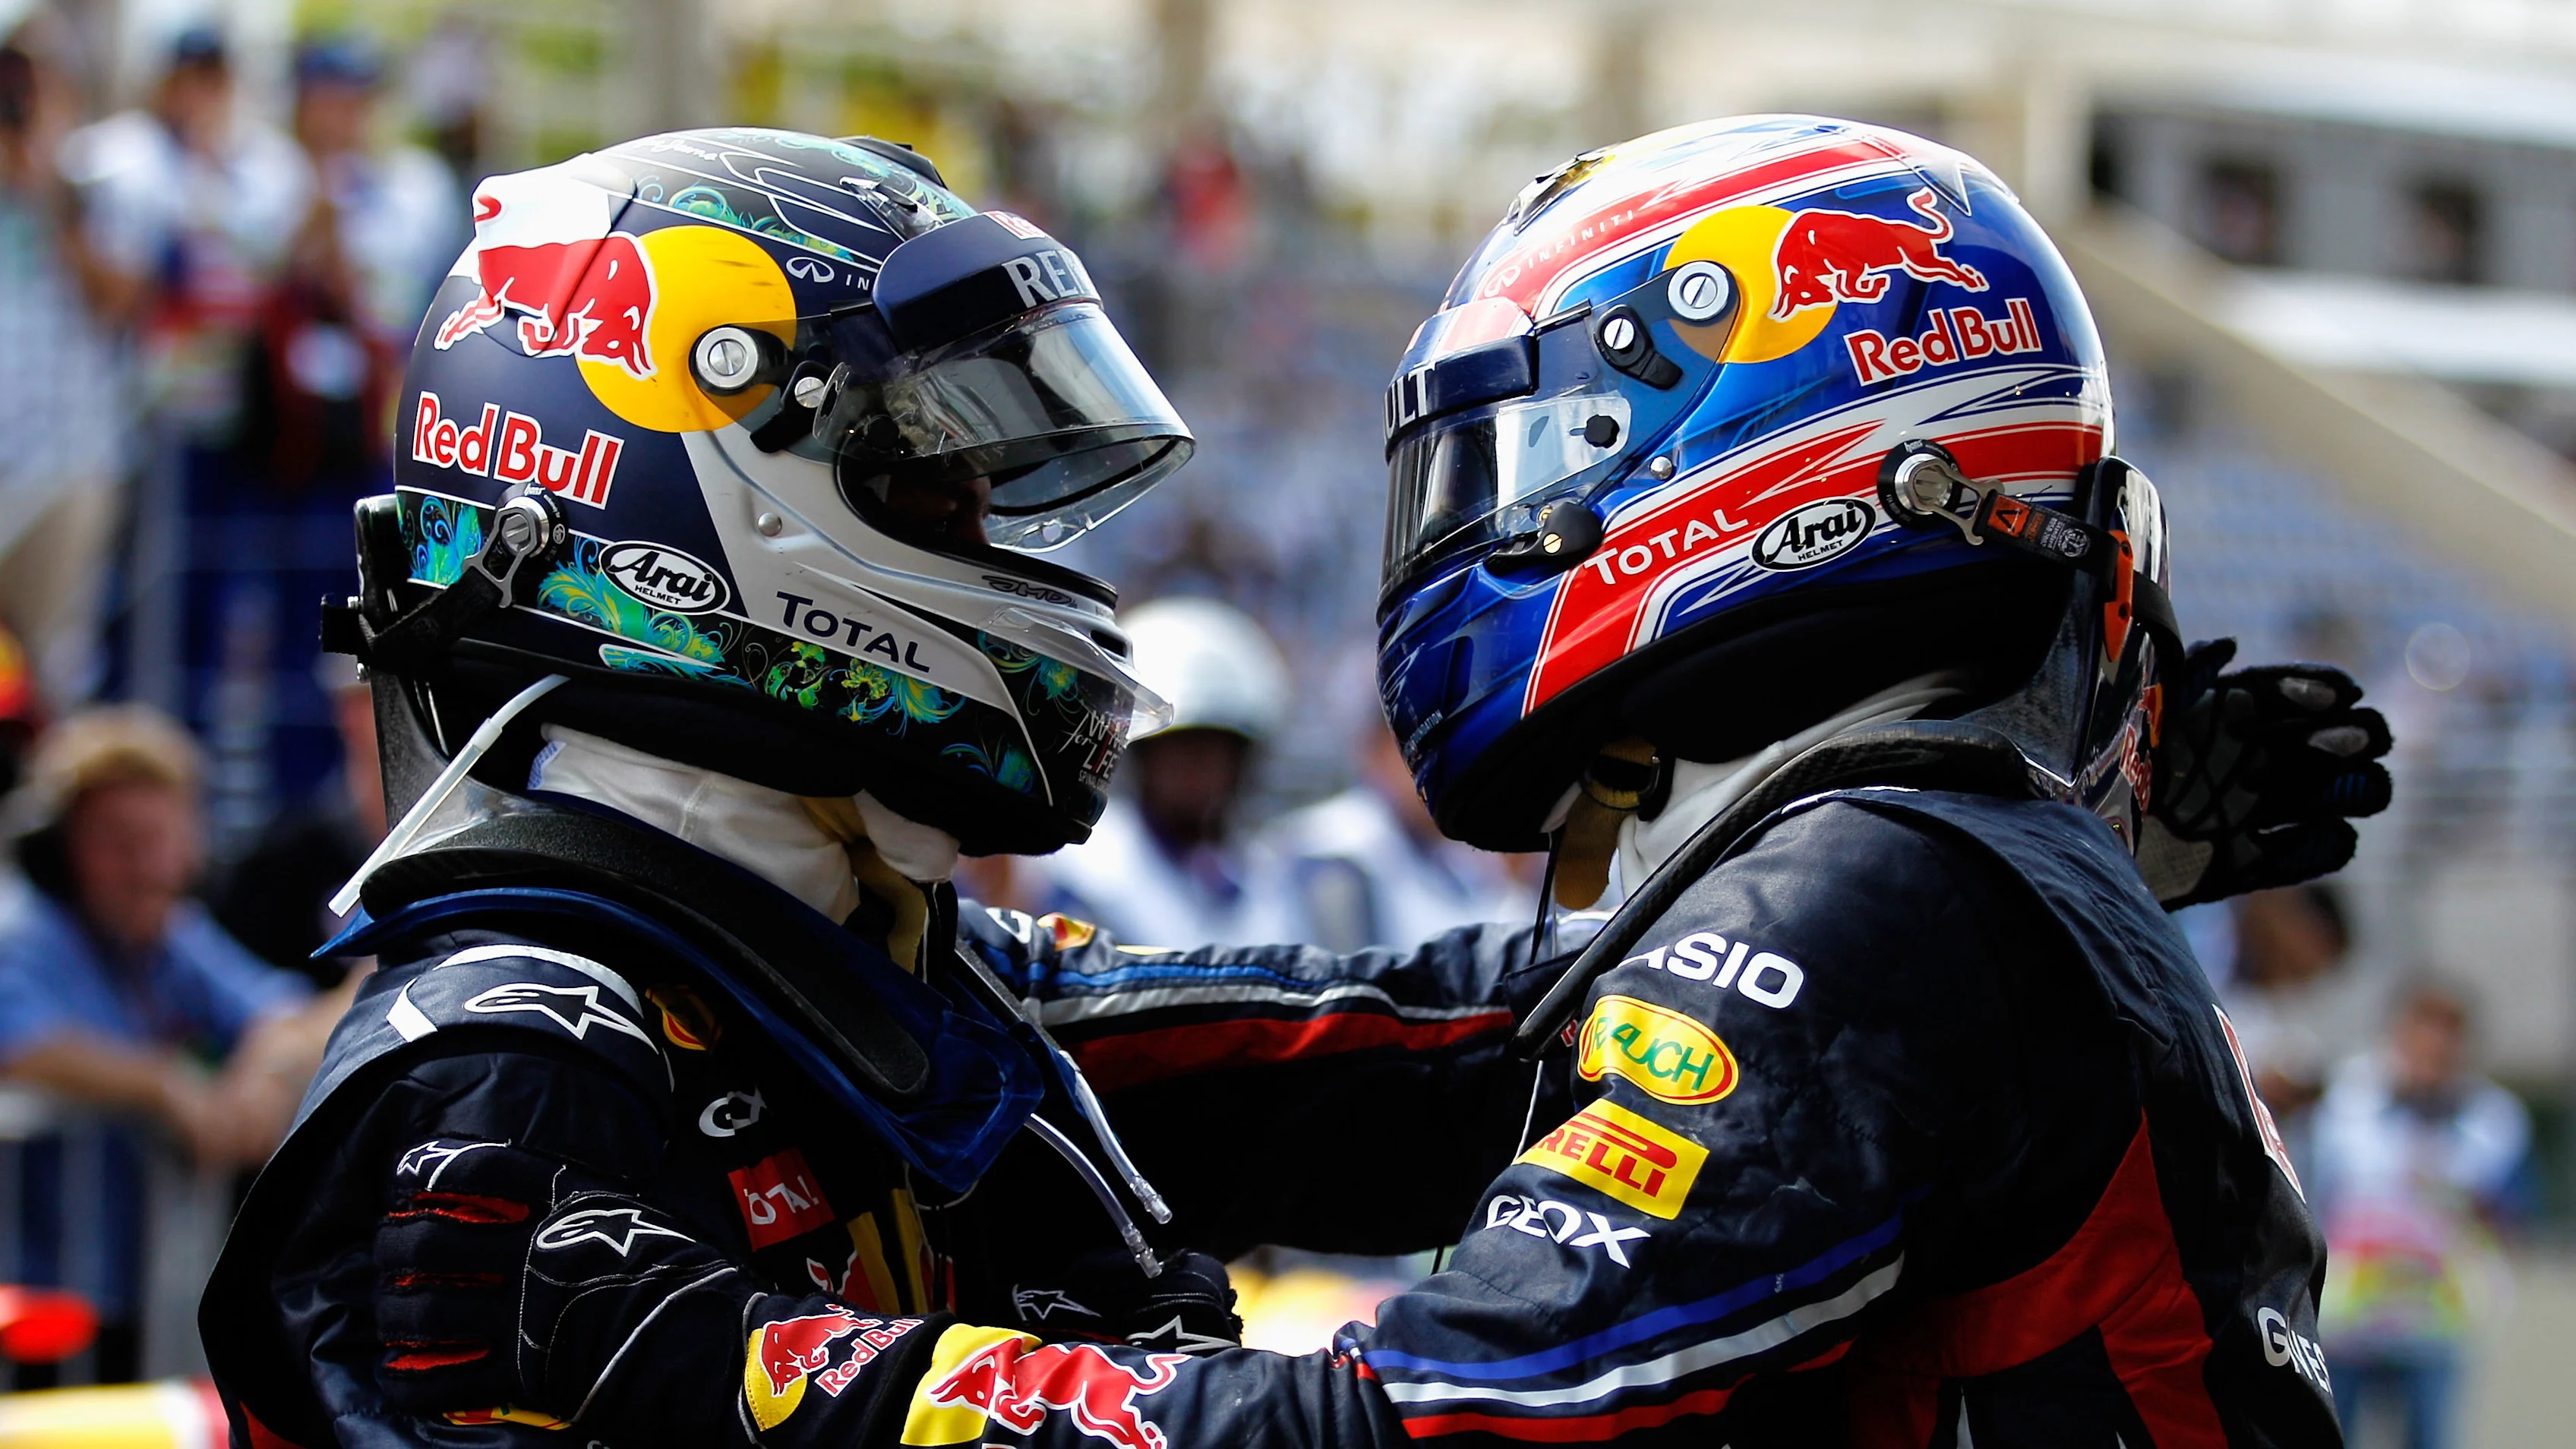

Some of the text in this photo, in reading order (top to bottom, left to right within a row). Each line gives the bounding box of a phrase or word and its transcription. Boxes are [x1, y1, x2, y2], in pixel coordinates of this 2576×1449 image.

[1527, 210, 1634, 269] INFINITI
[1843, 298, 2044, 387] Red Bull
[413, 391, 624, 510] Red Bull
[1583, 508, 1749, 585] TOTAL
[1762, 500, 1864, 564] Arai
[1798, 539, 1843, 561] HELMET
[607, 551, 715, 601] Arai
[634, 585, 681, 605] HELMET
[775, 591, 930, 674] TOTAL
[1592, 1016, 1714, 1091] RAUCH
[1530, 1128, 1666, 1198] RELLI
[1484, 1195, 1652, 1269] GEOX
[814, 1318, 925, 1397] Red Bull
